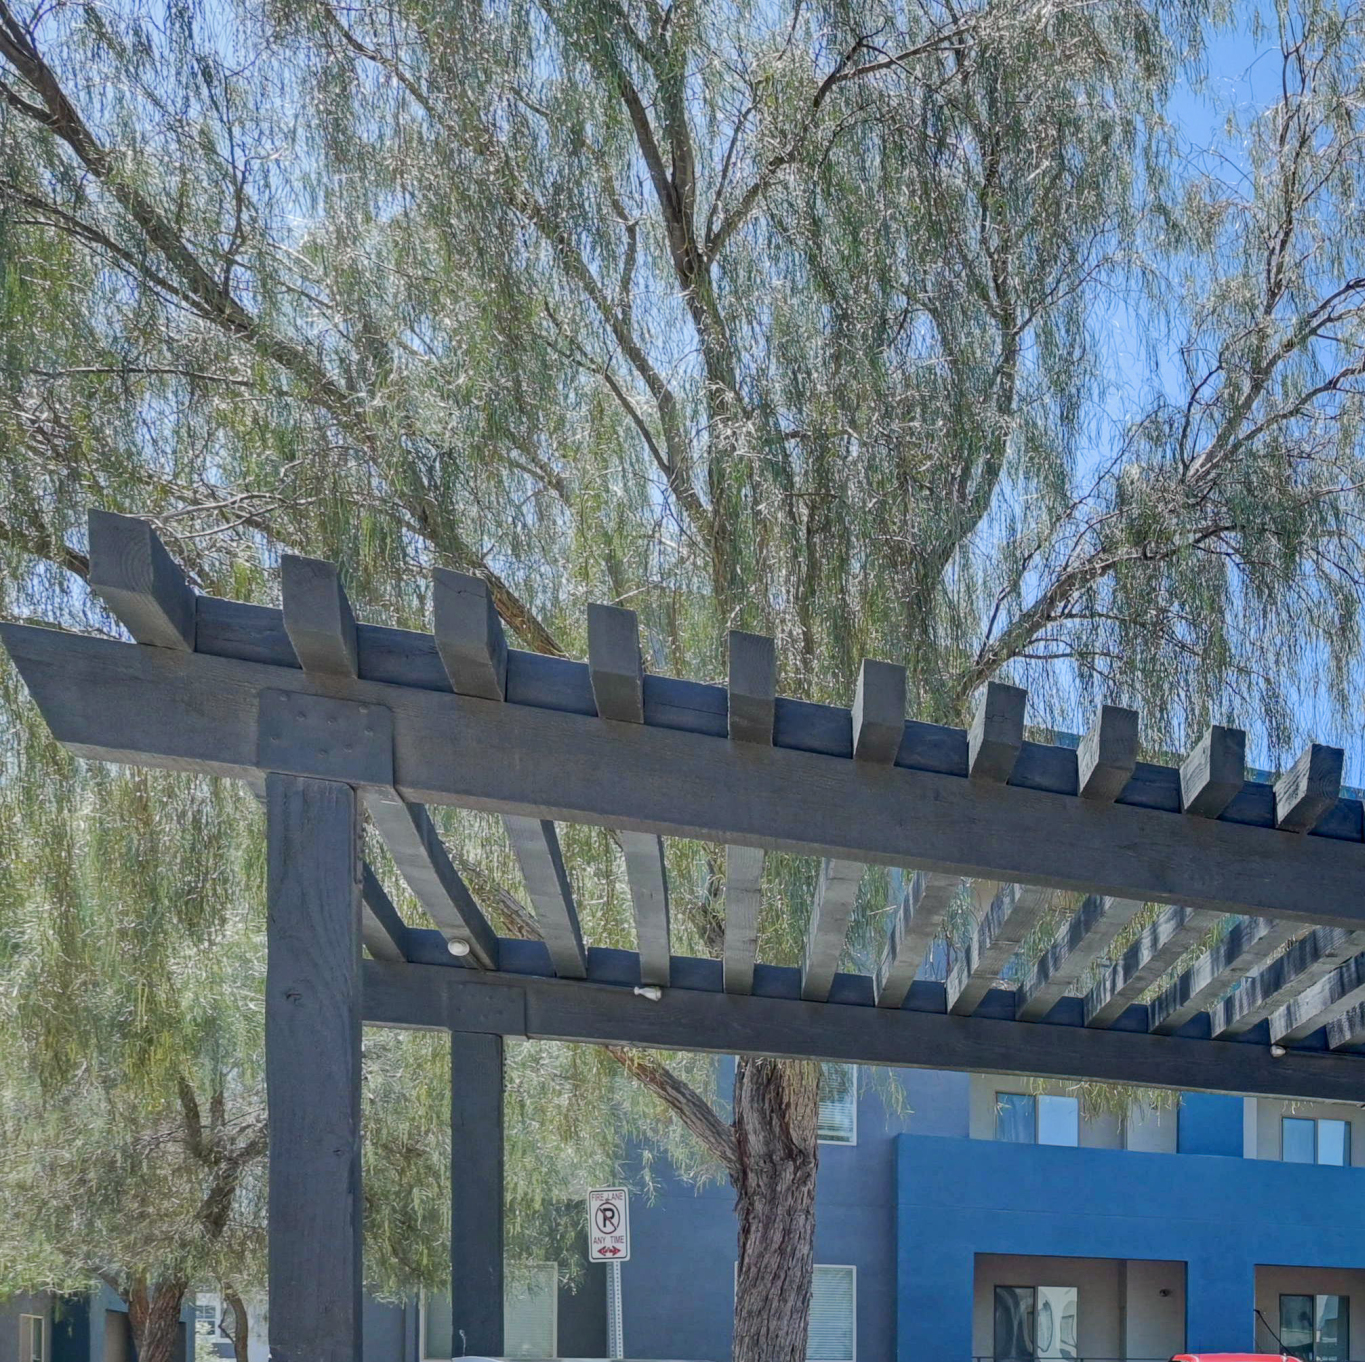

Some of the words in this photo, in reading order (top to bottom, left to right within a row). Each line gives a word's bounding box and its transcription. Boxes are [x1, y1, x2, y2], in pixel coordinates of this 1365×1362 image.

[592, 1193, 604, 1201] FIRE
[606, 1192, 623, 1201] LANE
[603, 1208, 615, 1228] P
[593, 1236, 606, 1244] ANY
[610, 1235, 625, 1243] TIME
